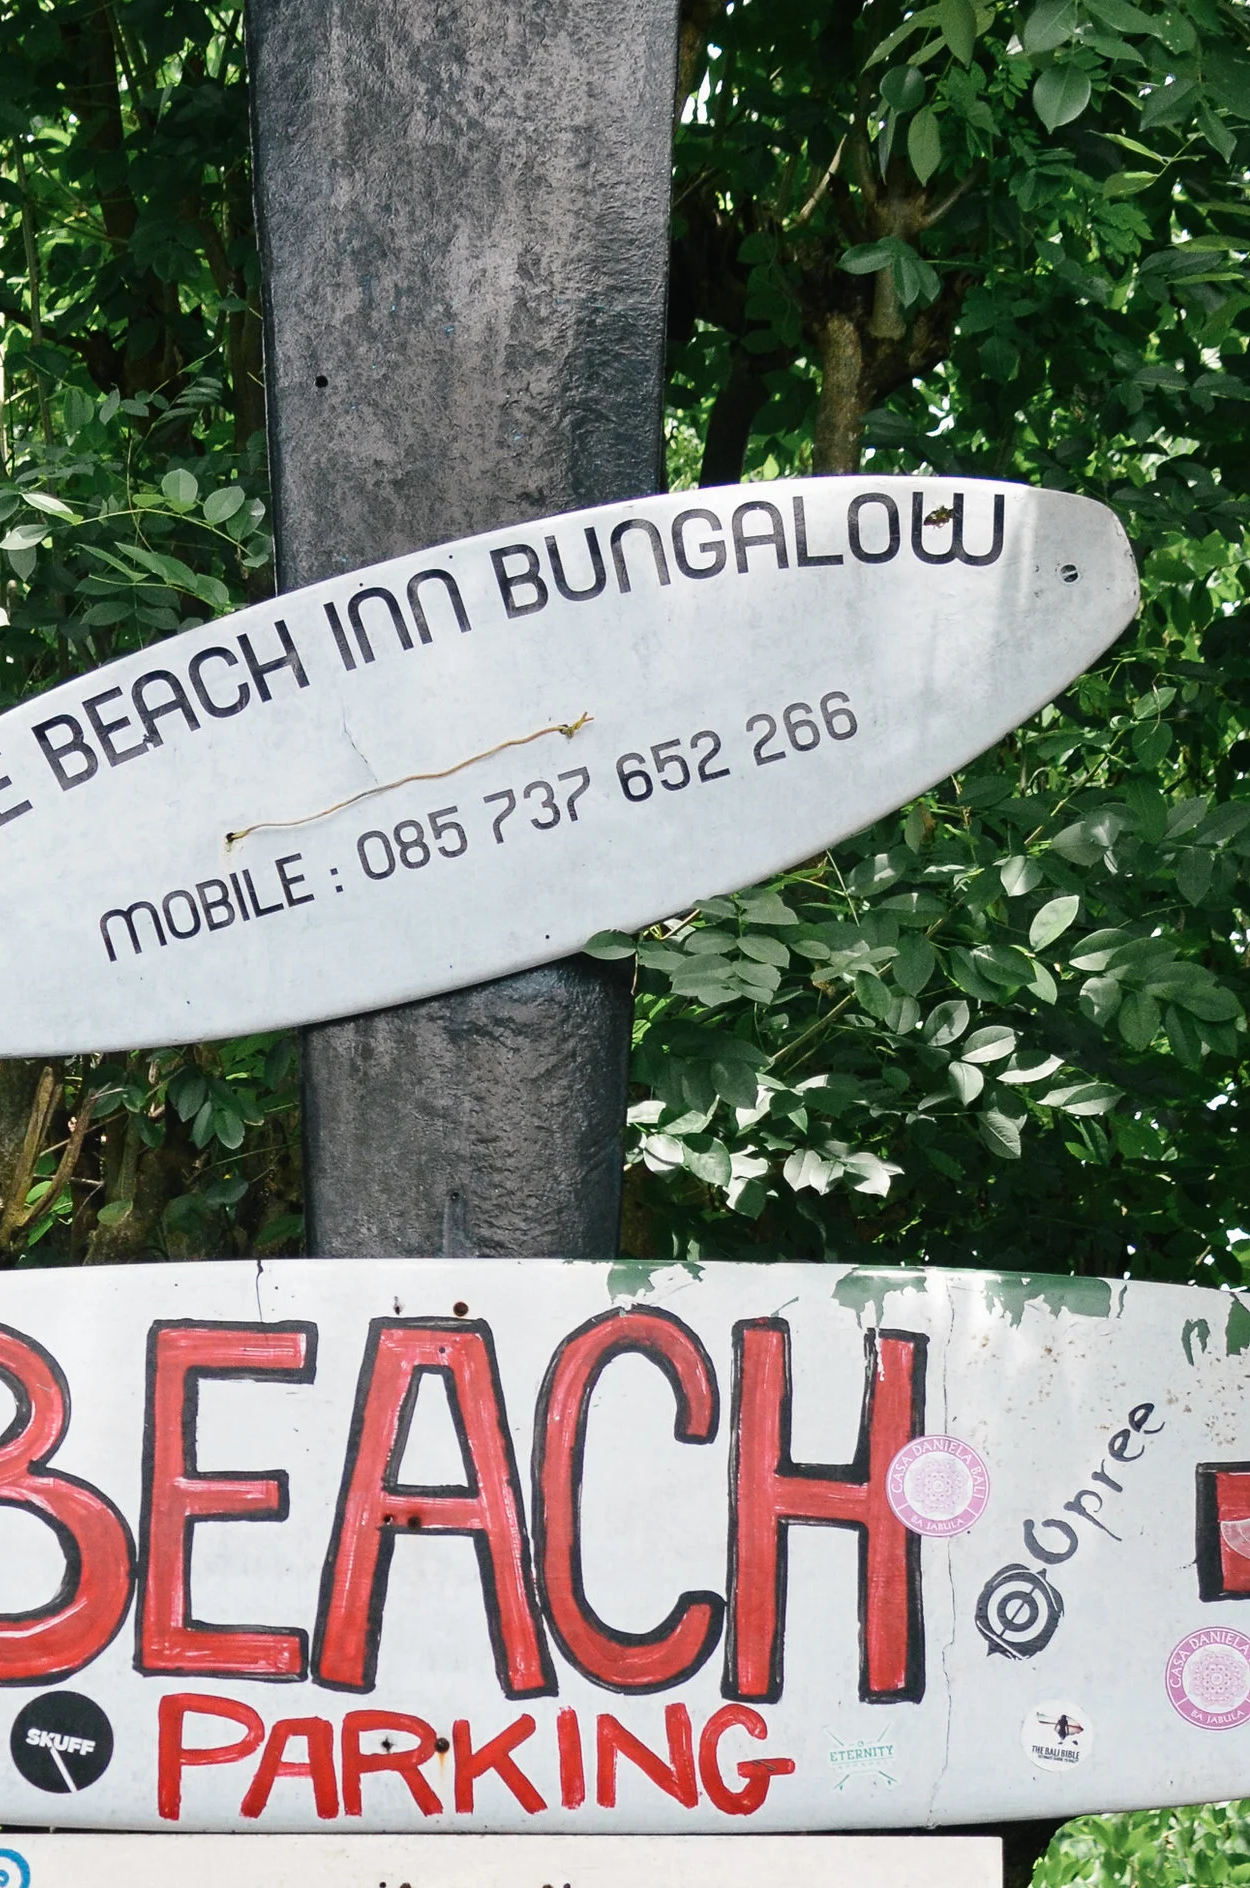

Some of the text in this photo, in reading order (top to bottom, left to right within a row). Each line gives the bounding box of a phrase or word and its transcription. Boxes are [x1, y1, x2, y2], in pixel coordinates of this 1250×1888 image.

[31, 618, 312, 792] BEACH
[323, 567, 472, 672] INN
[489, 490, 1006, 620] BUNGALOW
[99, 853, 315, 963] MOBILE
[355, 807, 469, 882] 085
[481, 766, 592, 846] 737
[614, 729, 731, 803] 652
[744, 690, 859, 767] 266
[891, 1439, 986, 1500] CASA DANIELA BALI
[1170, 1631, 1250, 1689] CASA DANIELA
[25, 1727, 96, 1756] SKUFF
[157, 1691, 796, 1820] PARKING
[830, 1745, 893, 1761] ETERNITY
